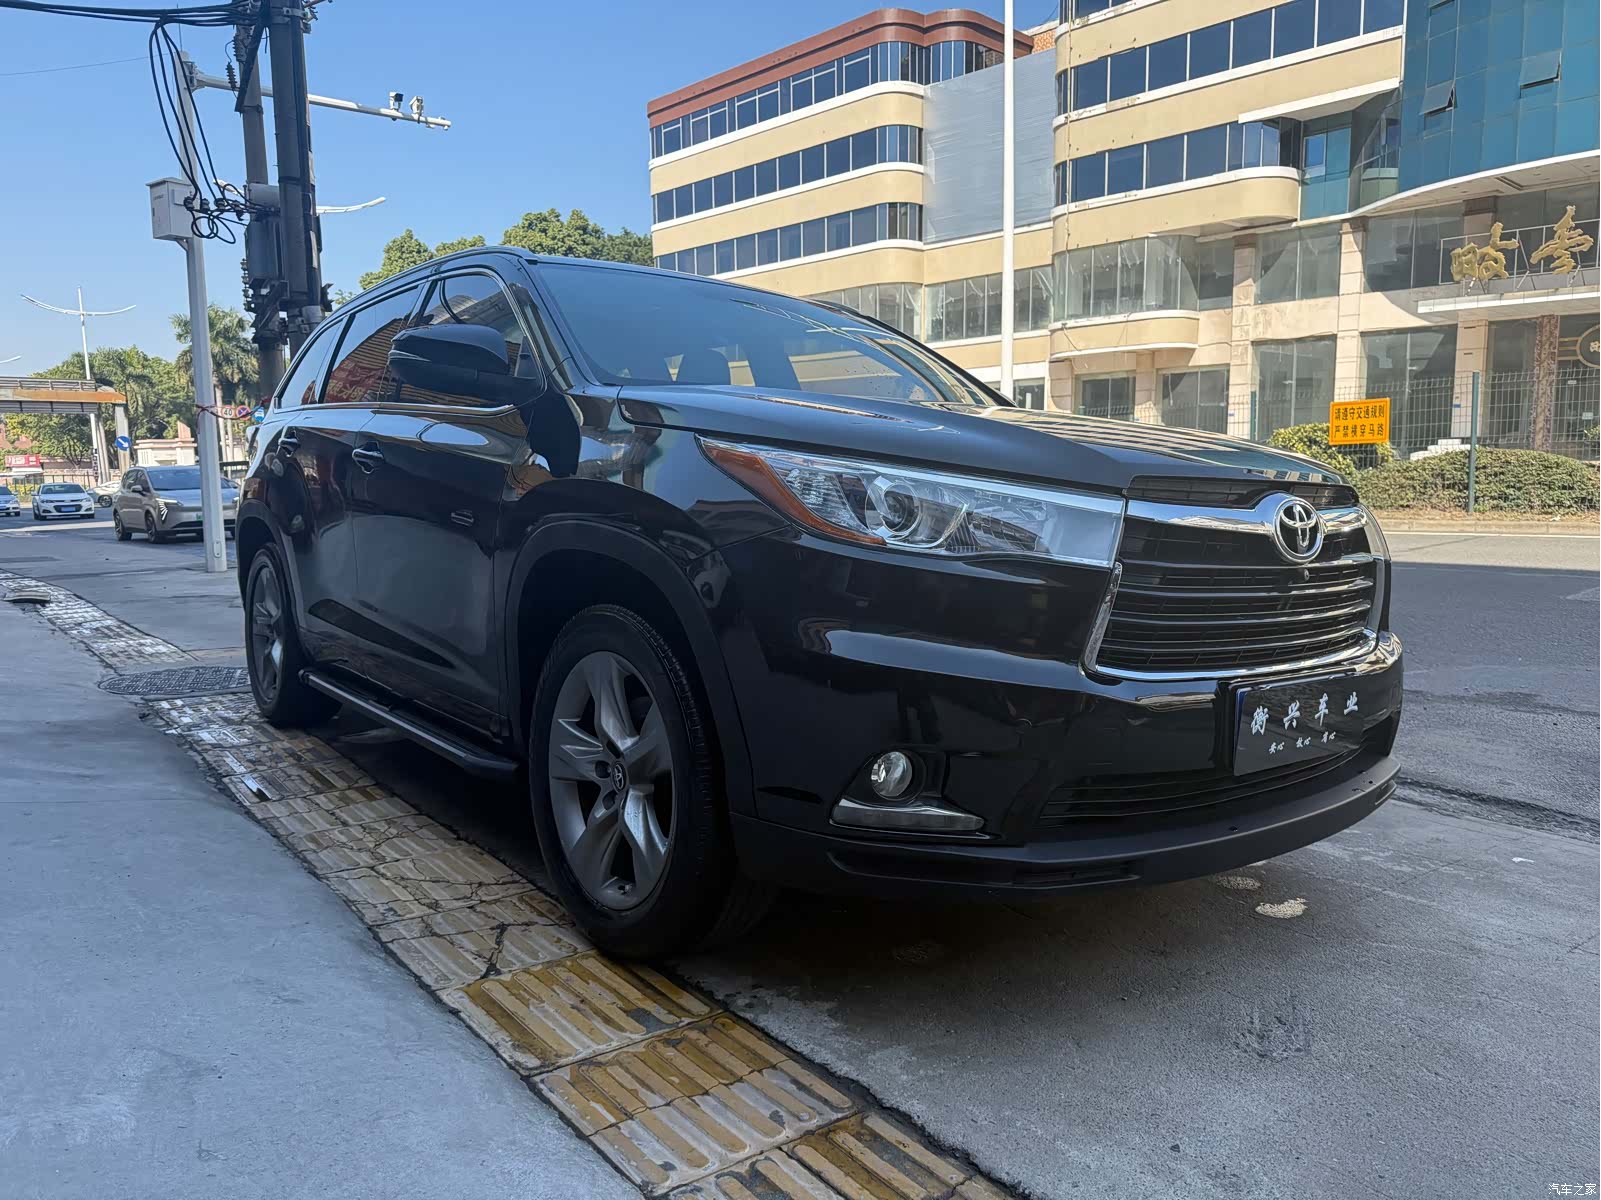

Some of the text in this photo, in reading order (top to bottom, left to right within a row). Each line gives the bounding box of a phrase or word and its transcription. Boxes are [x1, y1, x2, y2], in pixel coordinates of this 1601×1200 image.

[223, 408, 232, 416] 40
[1335, 404, 1385, 421] 请遵守交通规则
[1334, 422, 1384, 438] 严禁横穿马路
